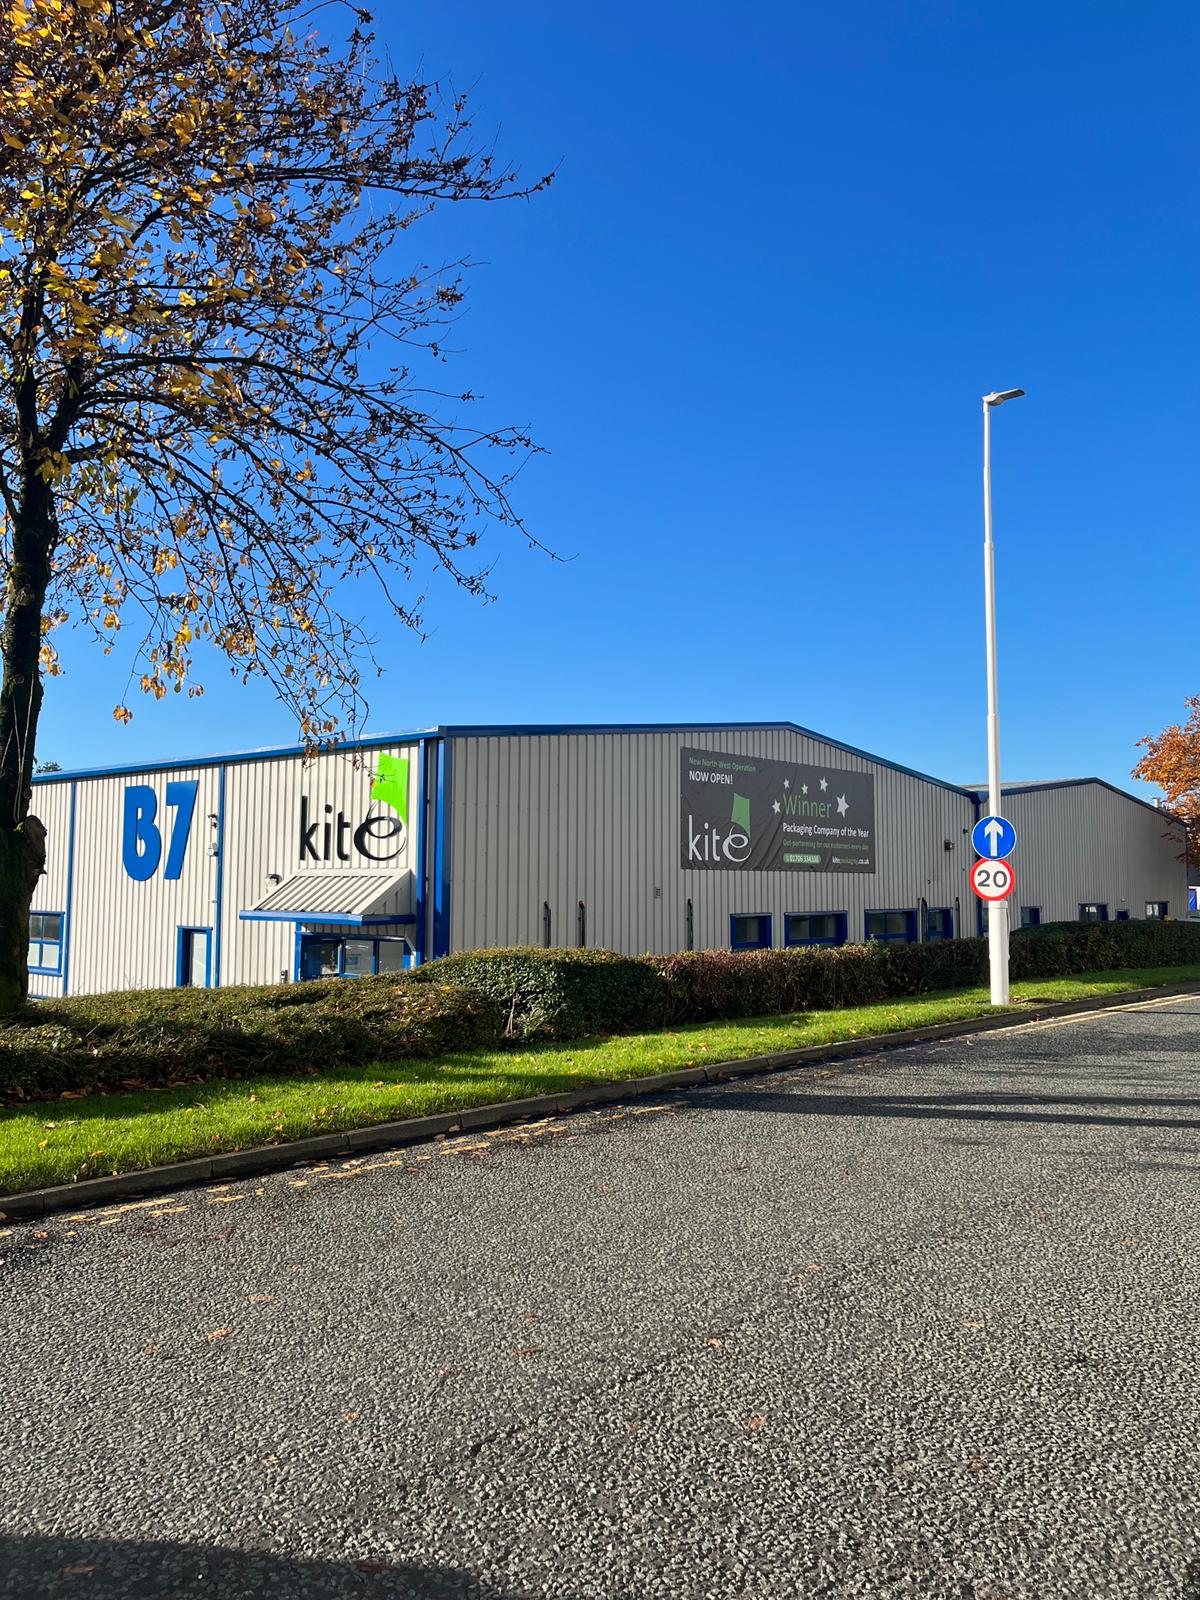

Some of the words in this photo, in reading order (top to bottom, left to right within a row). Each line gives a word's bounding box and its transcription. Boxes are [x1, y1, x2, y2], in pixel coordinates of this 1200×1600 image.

[689, 770, 709, 783] NOW
[710, 772, 733, 785] OPEN!
[783, 793, 832, 818] Winner
[122, 780, 199, 881] B7
[300, 796, 408, 861] kite
[688, 814, 752, 862] kite
[783, 822, 813, 836] Packaging
[813, 825, 840, 837] Company
[840, 826, 847, 836] of
[848, 827, 857, 837] the
[857, 828, 869, 838] Year
[977, 869, 1008, 888] 20
